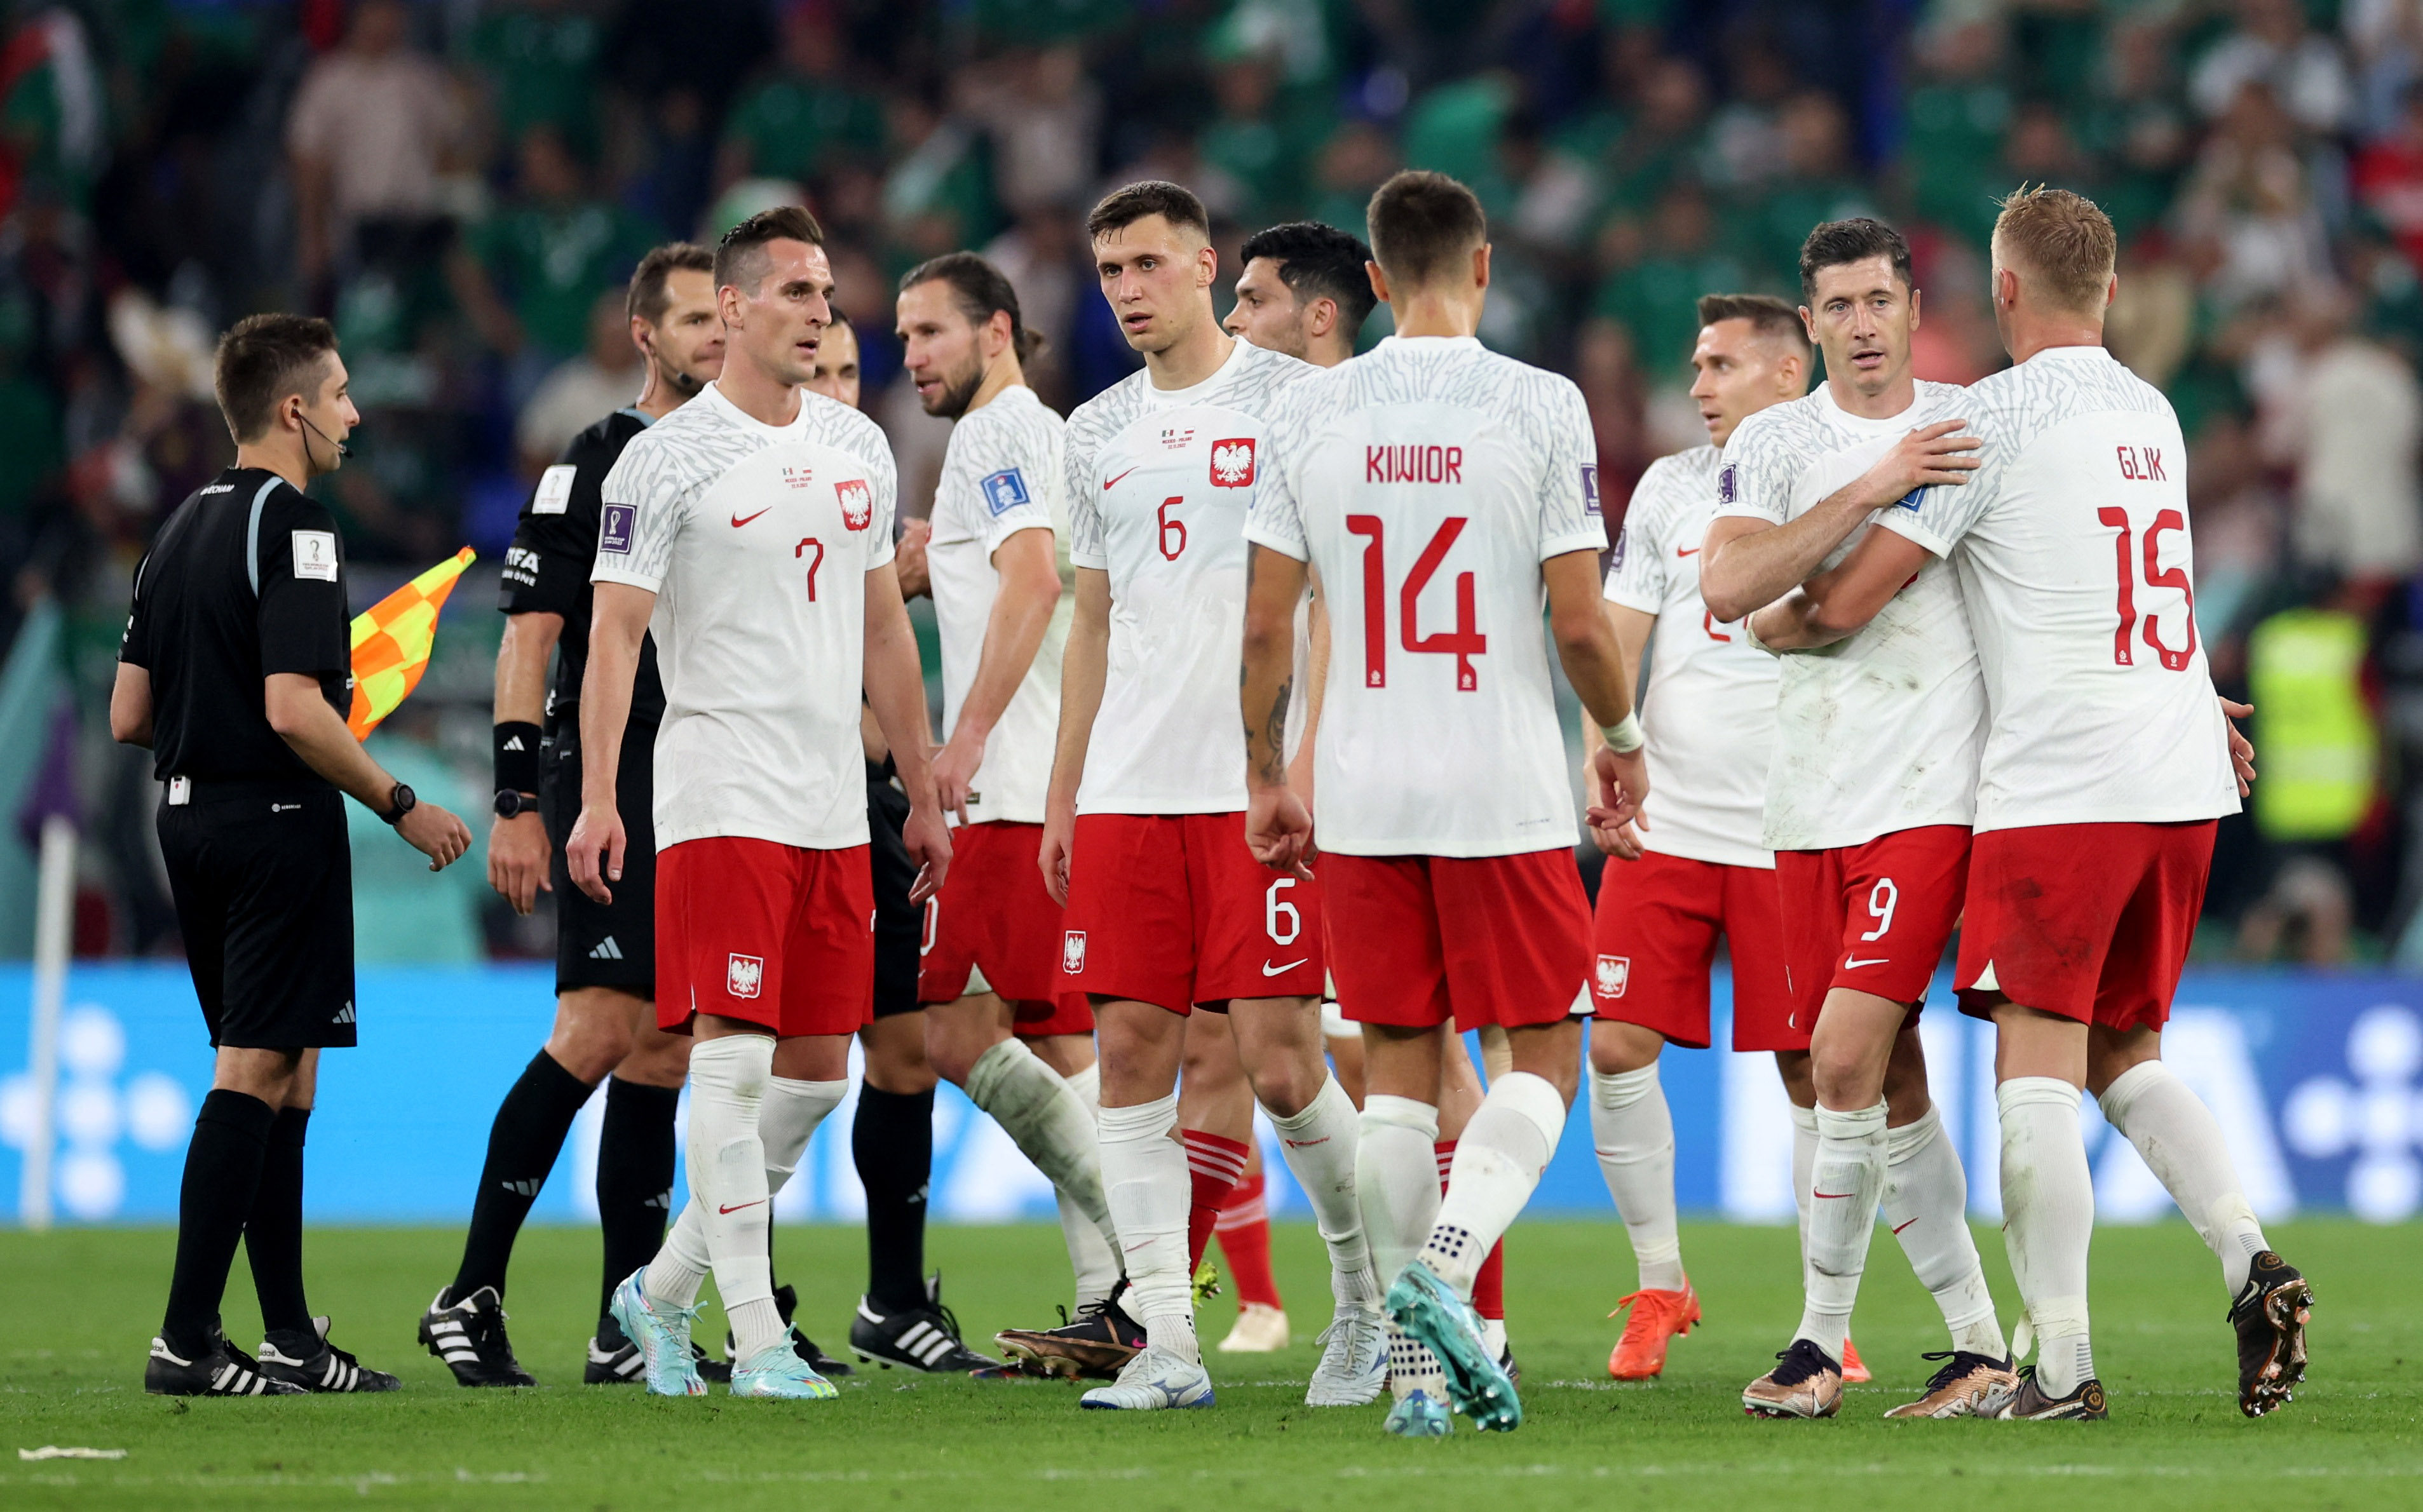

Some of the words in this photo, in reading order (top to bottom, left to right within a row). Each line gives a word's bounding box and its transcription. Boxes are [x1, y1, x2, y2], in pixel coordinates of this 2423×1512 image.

[1366, 445, 1463, 484] KIWIOR
[2116, 446, 2166, 482] GLIK
[1158, 496, 1187, 562] 6
[513, 570, 537, 587] ONE
[795, 537, 825, 602] 7
[1347, 513, 1488, 692] 14
[2098, 506, 2197, 672] 15
[1265, 877, 1301, 946] 6
[1860, 877, 1898, 943] 9
